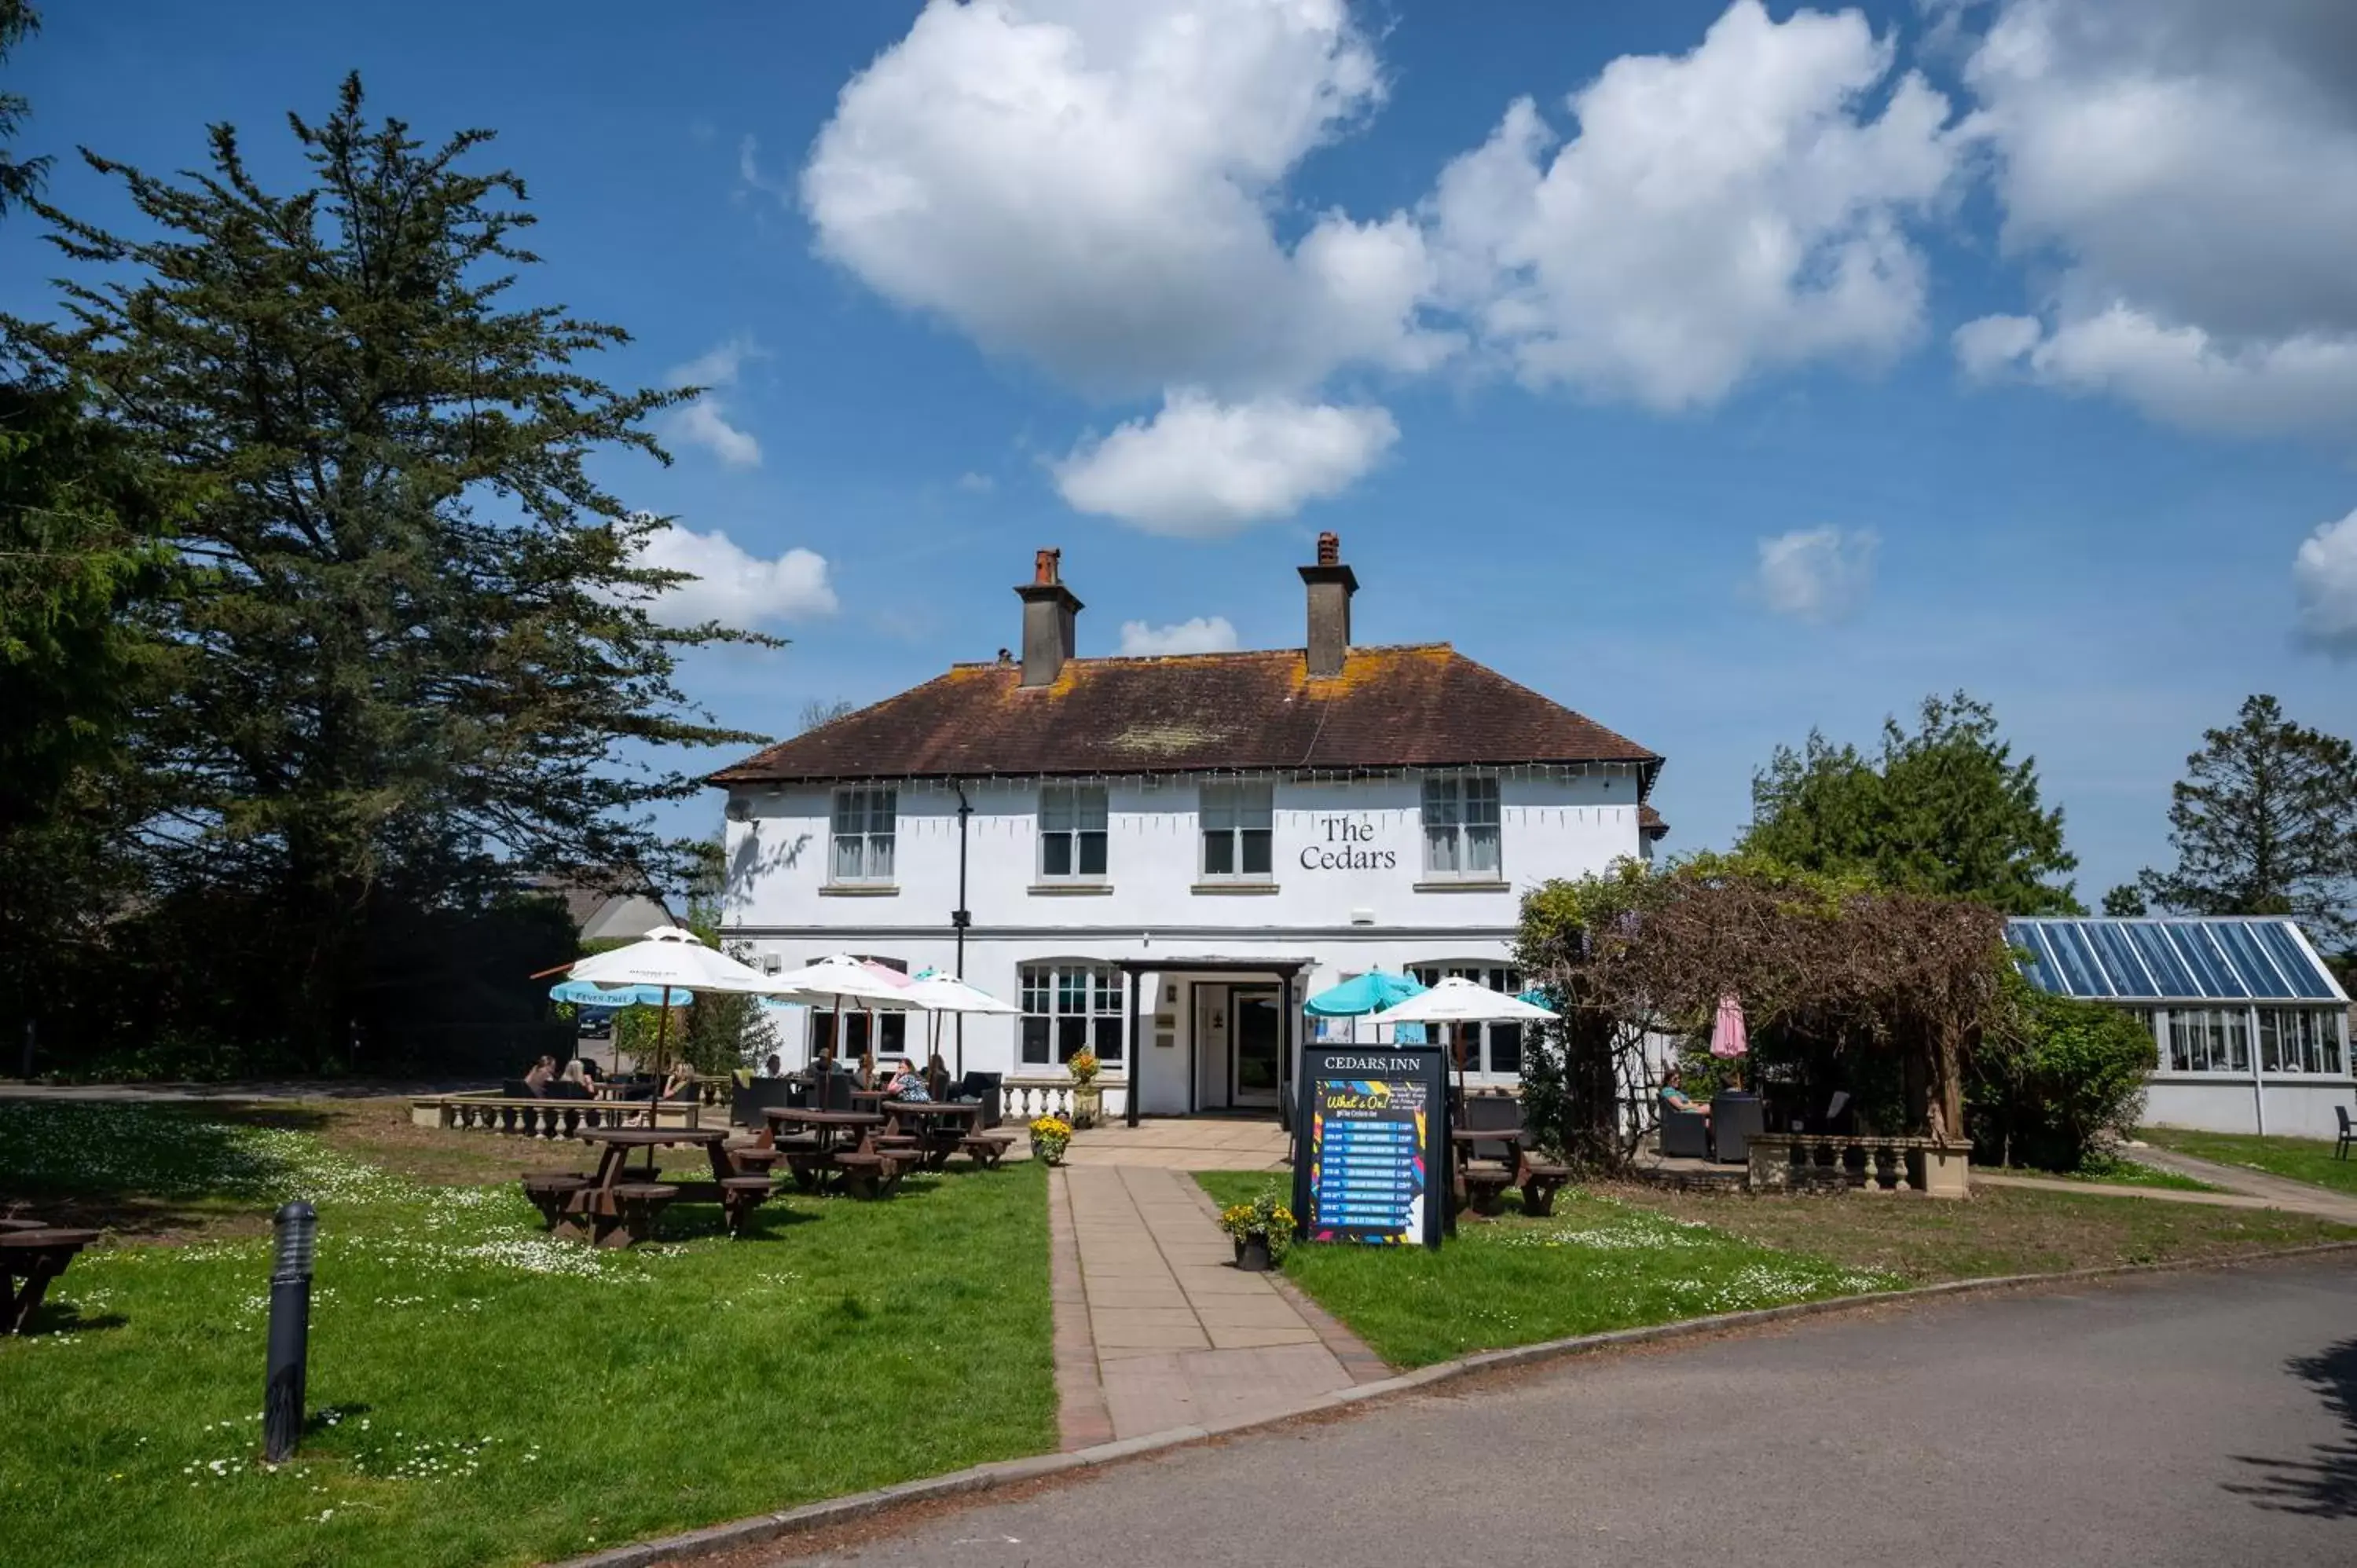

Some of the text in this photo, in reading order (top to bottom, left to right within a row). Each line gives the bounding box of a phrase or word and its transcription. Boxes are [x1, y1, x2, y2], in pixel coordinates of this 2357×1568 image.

[1321, 816, 1374, 841] The
[1300, 844, 1396, 870] Cedars
[1324, 1057, 1420, 1071] CEDARS INN
